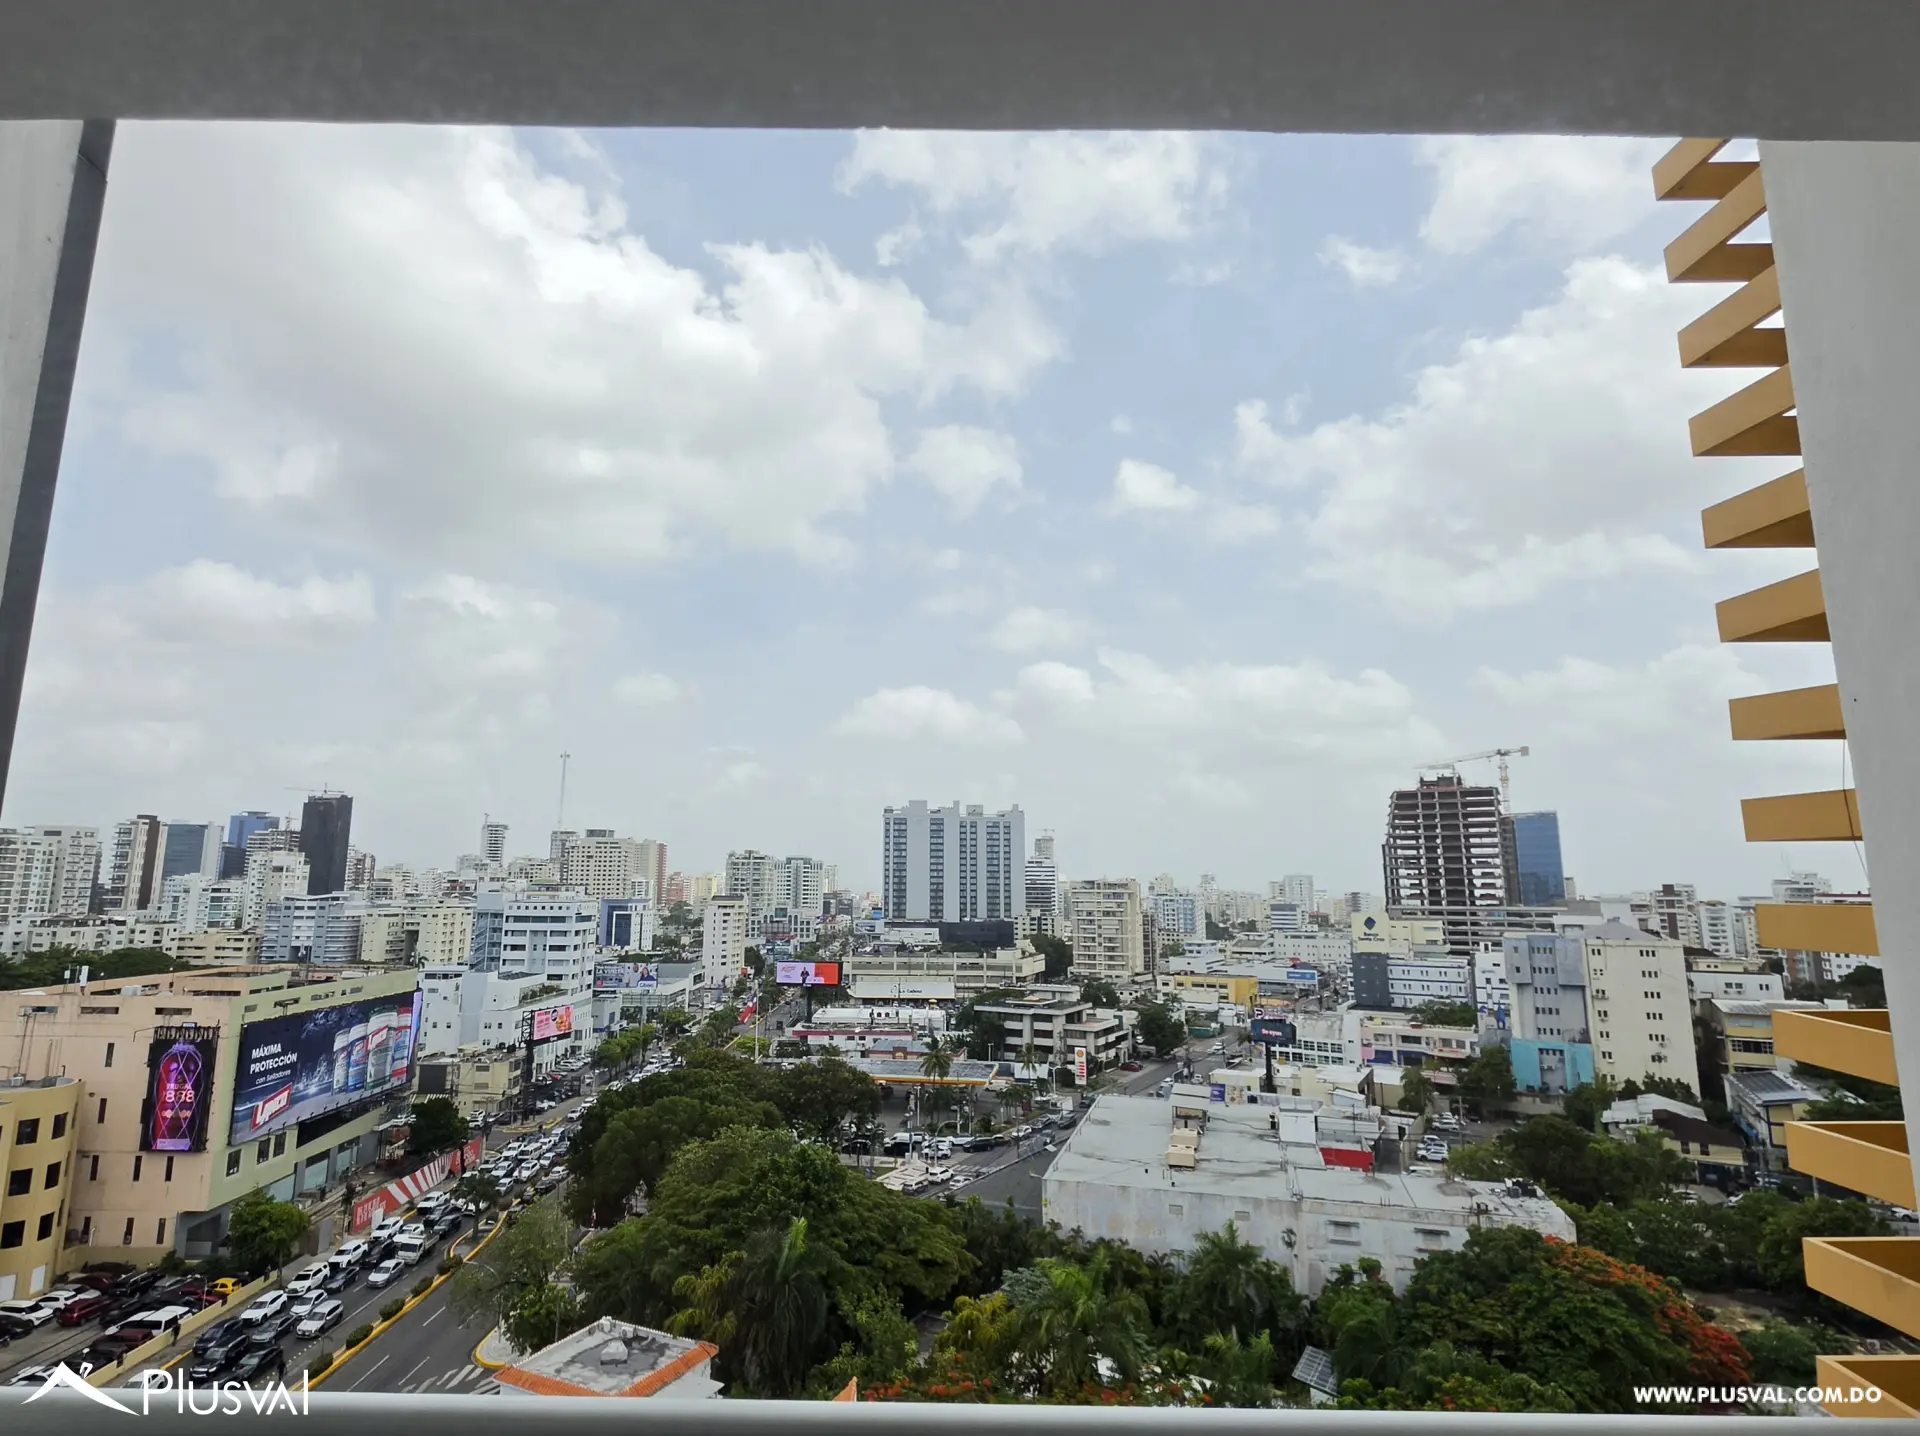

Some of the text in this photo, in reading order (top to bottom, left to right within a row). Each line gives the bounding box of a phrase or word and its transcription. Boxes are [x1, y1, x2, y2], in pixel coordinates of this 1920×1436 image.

[252, 1043, 281, 1059] MÁXIMA
[250, 1051, 298, 1074] PROTECCIÓN
[255, 1076, 266, 1085] con
